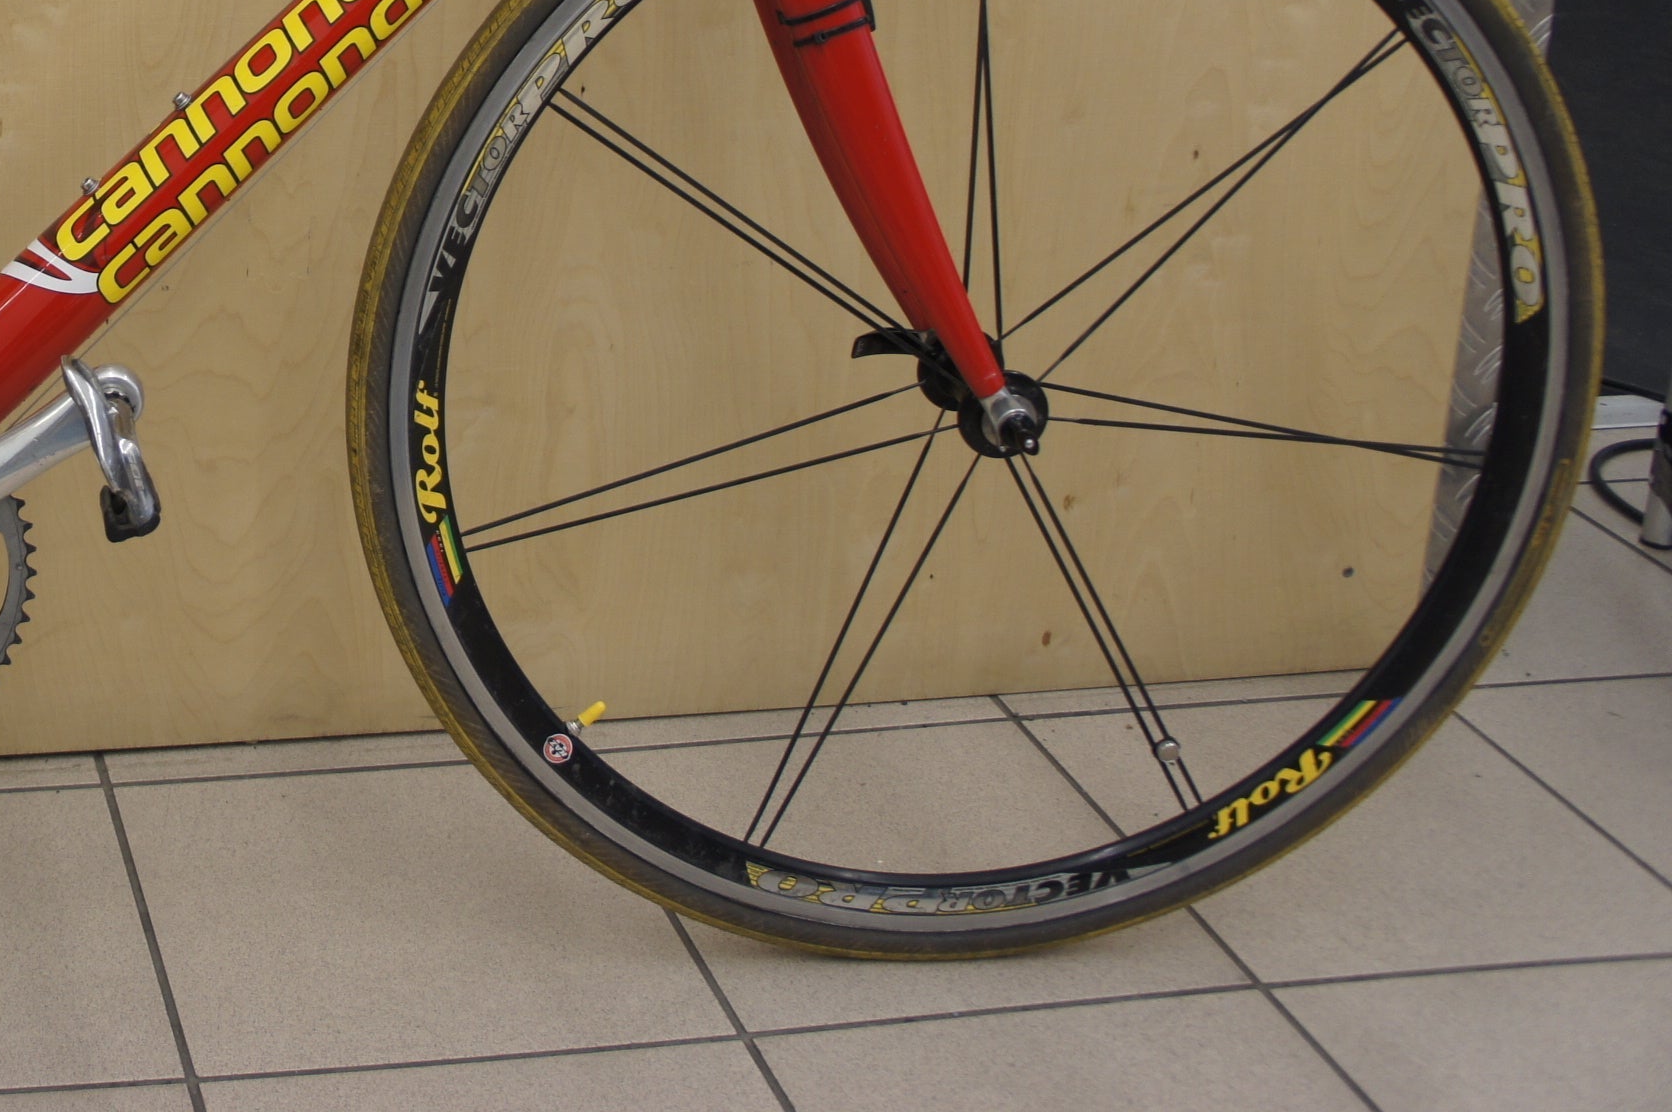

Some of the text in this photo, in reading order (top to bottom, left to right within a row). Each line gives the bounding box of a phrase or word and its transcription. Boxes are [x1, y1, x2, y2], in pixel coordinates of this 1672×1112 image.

[1475, 121, 1545, 306] PRO
[414, 379, 447, 524] Rolf
[1208, 748, 1333, 840] Rolf
